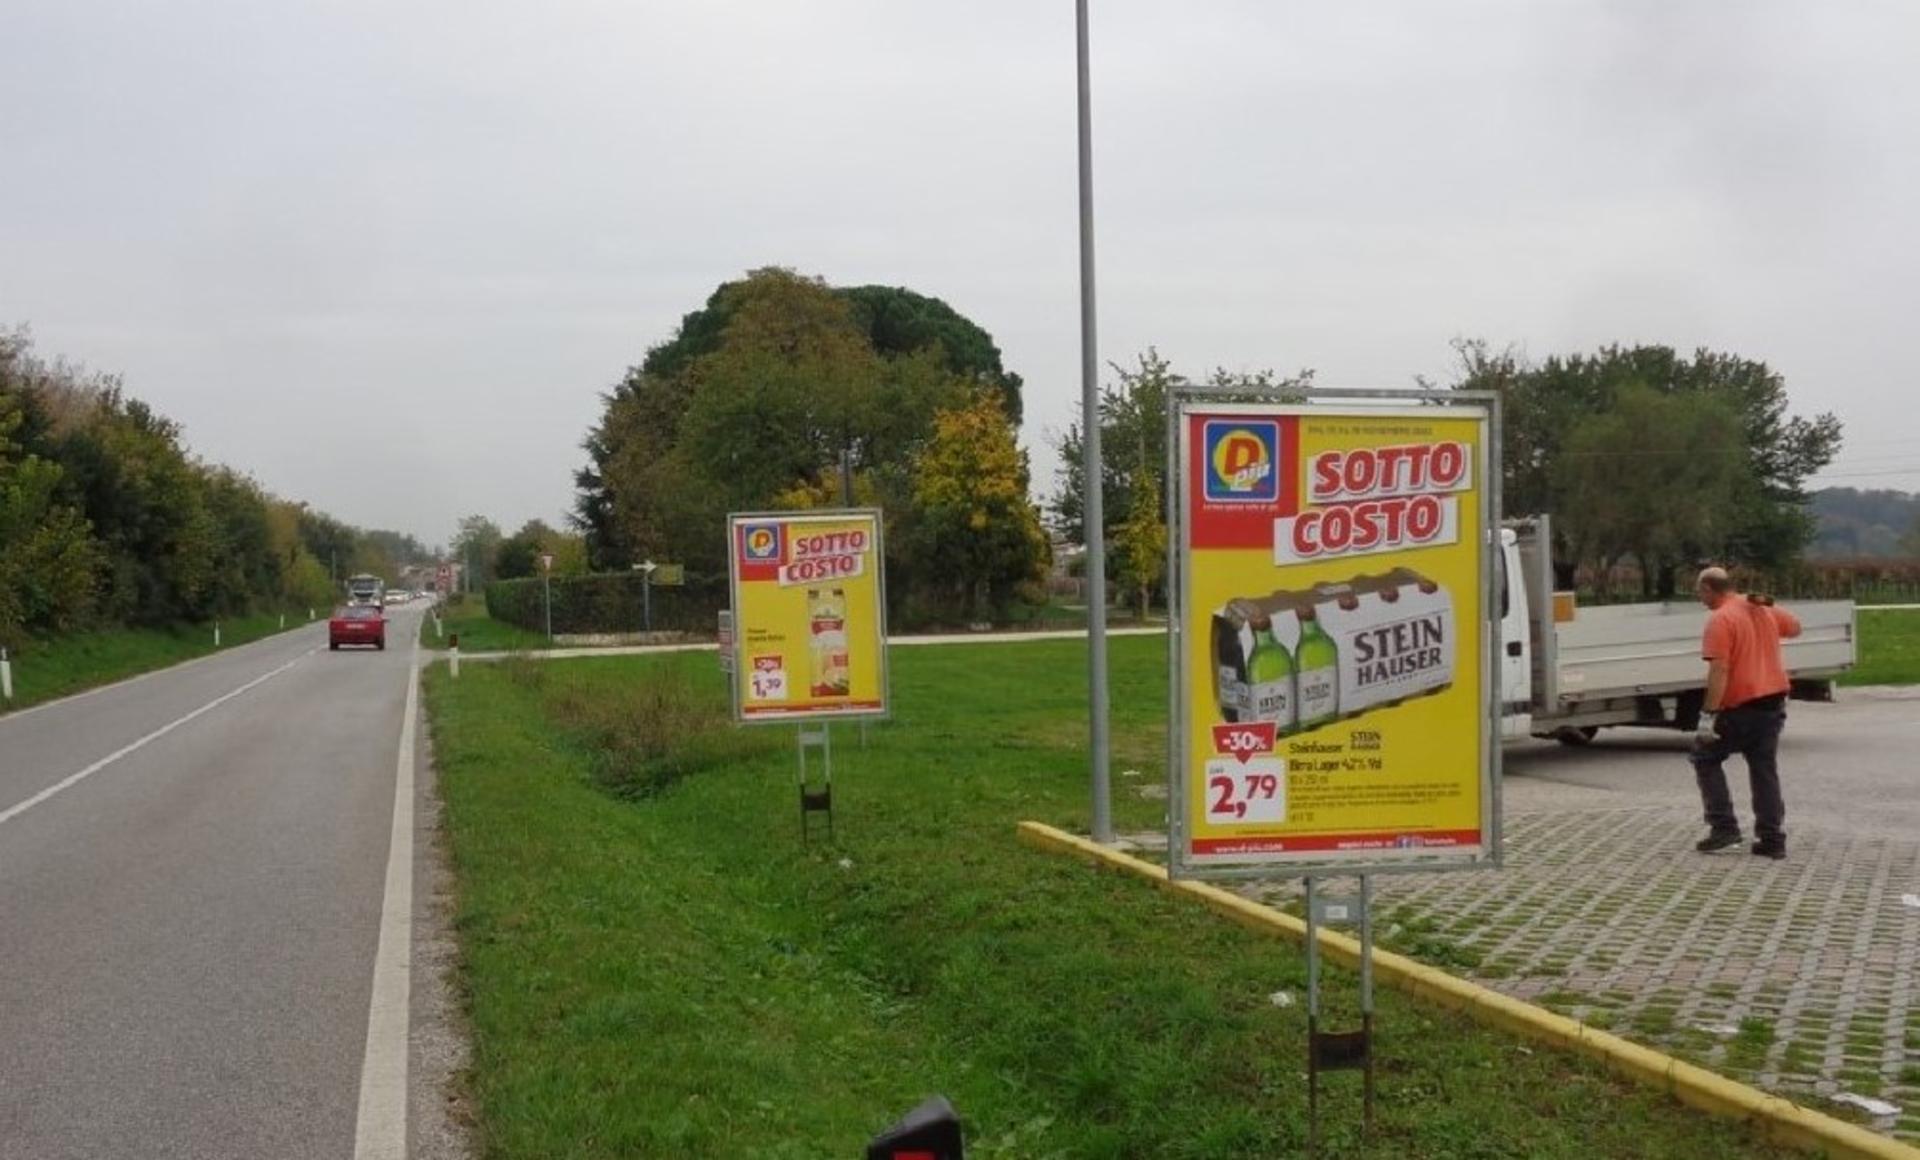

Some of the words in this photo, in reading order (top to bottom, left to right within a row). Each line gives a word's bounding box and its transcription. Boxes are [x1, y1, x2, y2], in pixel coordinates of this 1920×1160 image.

[1314, 440, 1463, 495] SOTTO
[796, 530, 865, 555] SOTTO
[1293, 496, 1441, 554] COSTO
[787, 555, 854, 582] COSTO
[1354, 615, 1442, 662] STEIN
[1357, 646, 1442, 686] HAUSER
[1222, 731, 1267, 751] -30%
[1209, 774, 1278, 818] 2,79
